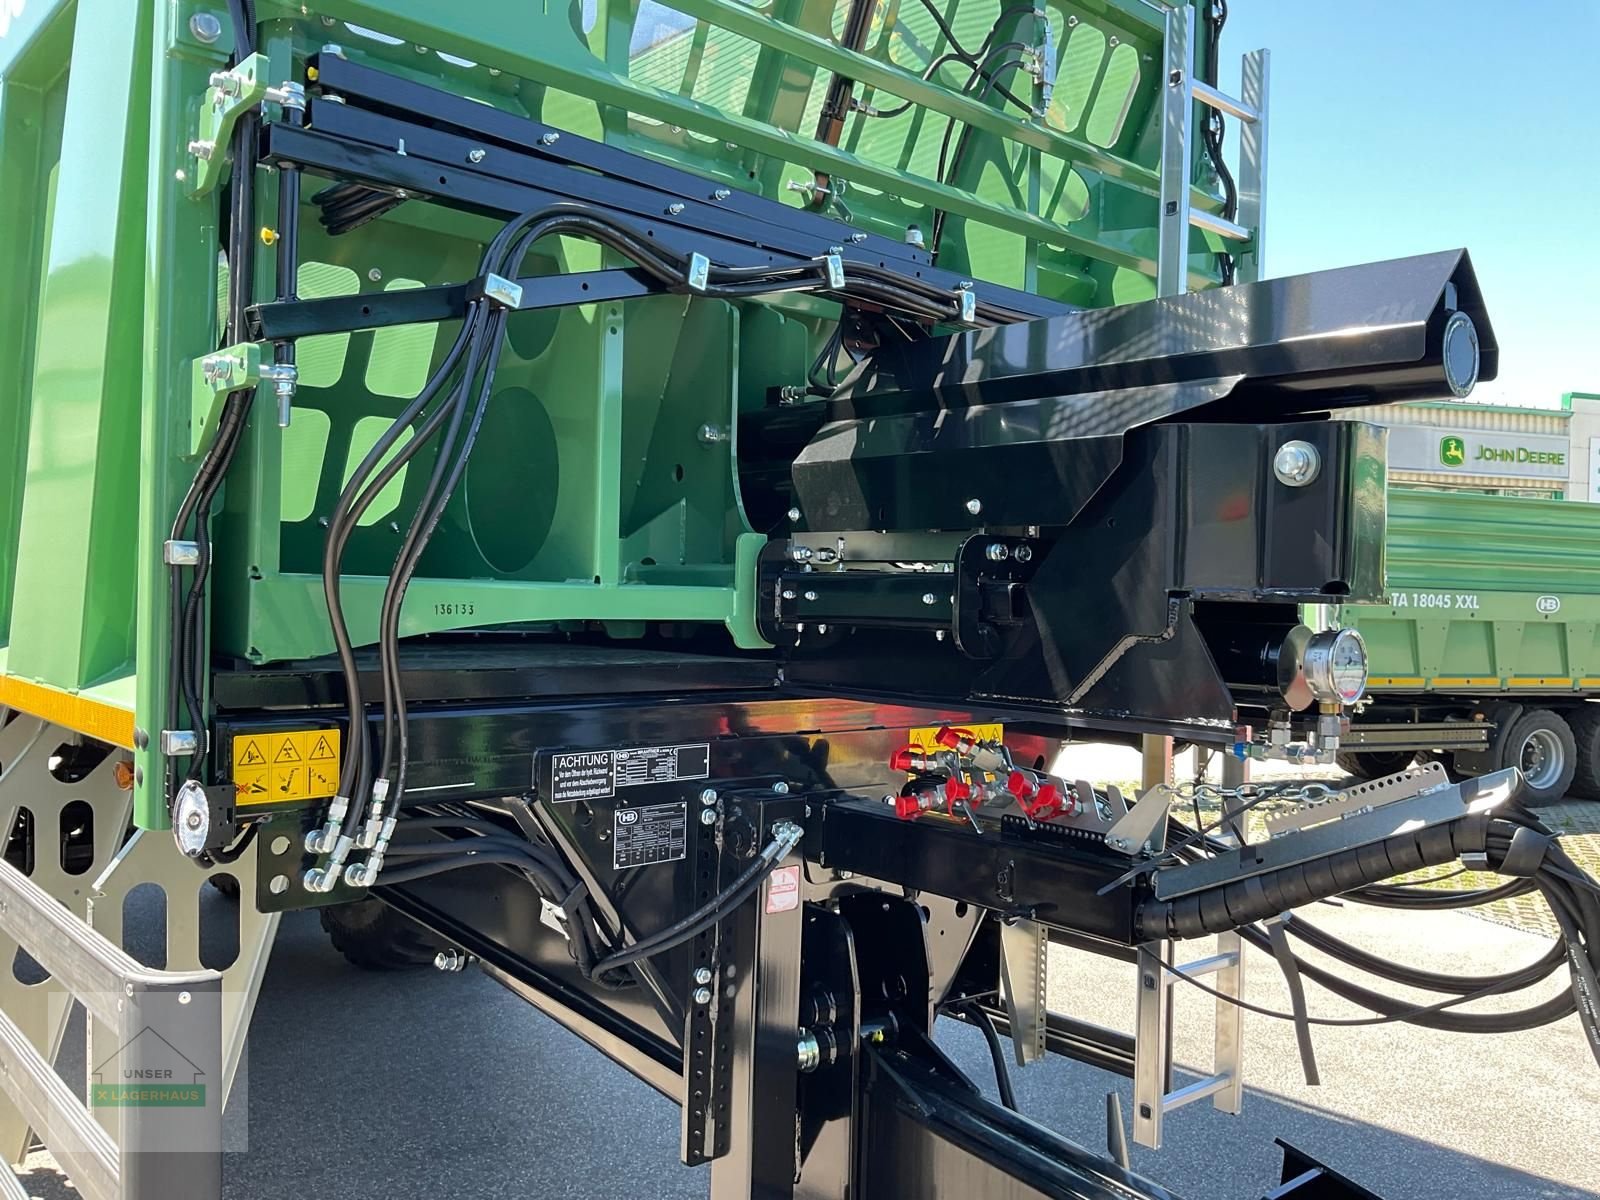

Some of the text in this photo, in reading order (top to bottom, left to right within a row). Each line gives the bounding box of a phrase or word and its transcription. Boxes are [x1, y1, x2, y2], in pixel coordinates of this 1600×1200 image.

[1474, 444, 1565, 465] JOHN DEERE
[1391, 592, 1479, 609] TA 18045 XXL
[435, 603, 474, 615] 136133
[559, 753, 608, 769] ACHTUNG
